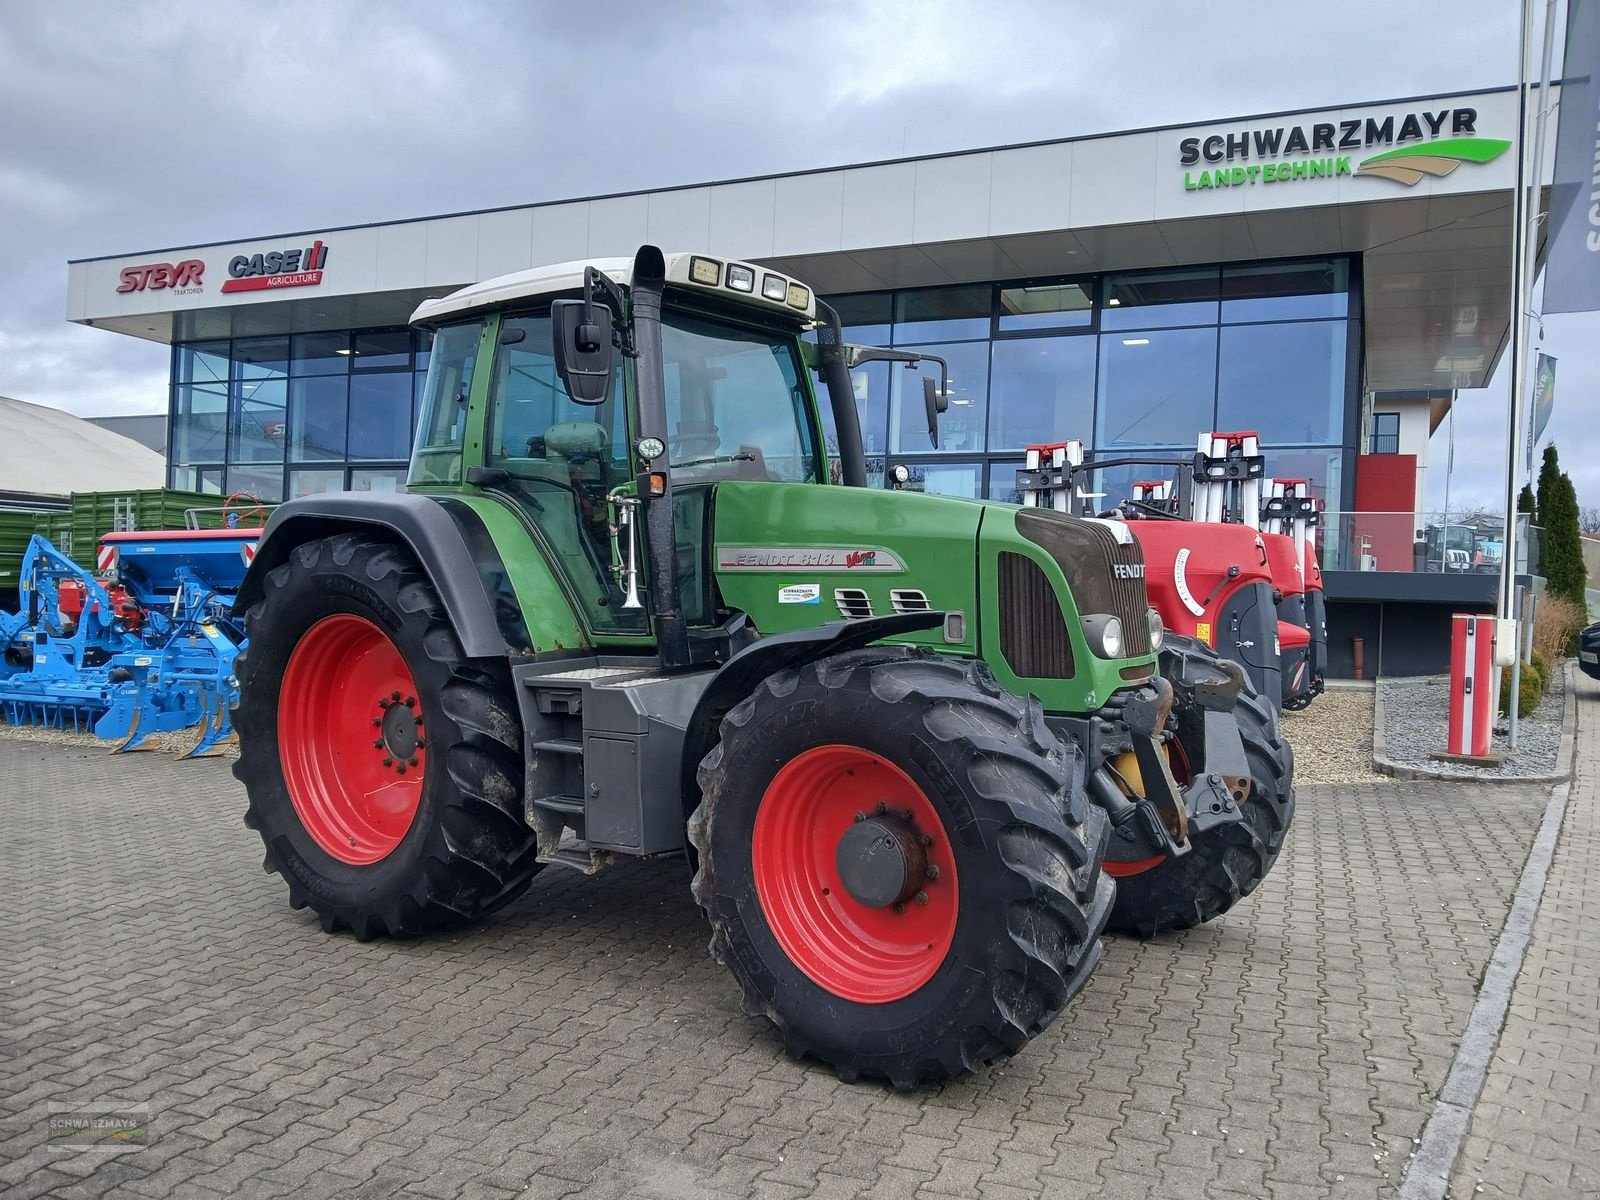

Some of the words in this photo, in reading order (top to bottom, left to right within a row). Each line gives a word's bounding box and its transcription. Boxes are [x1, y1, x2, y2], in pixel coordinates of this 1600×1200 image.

[1180, 108, 1478, 165] SCHWARZMAYR
[1184, 156, 1353, 191] LANDTECHNIK
[228, 249, 302, 278] CASE
[116, 259, 205, 293] STEYR
[266, 273, 318, 286] AGRICULTURE
[173, 287, 204, 296] TRAKTOREN
[736, 553, 795, 566] FENDT
[800, 553, 835, 566] 818
[1113, 564, 1145, 578] FENDT
